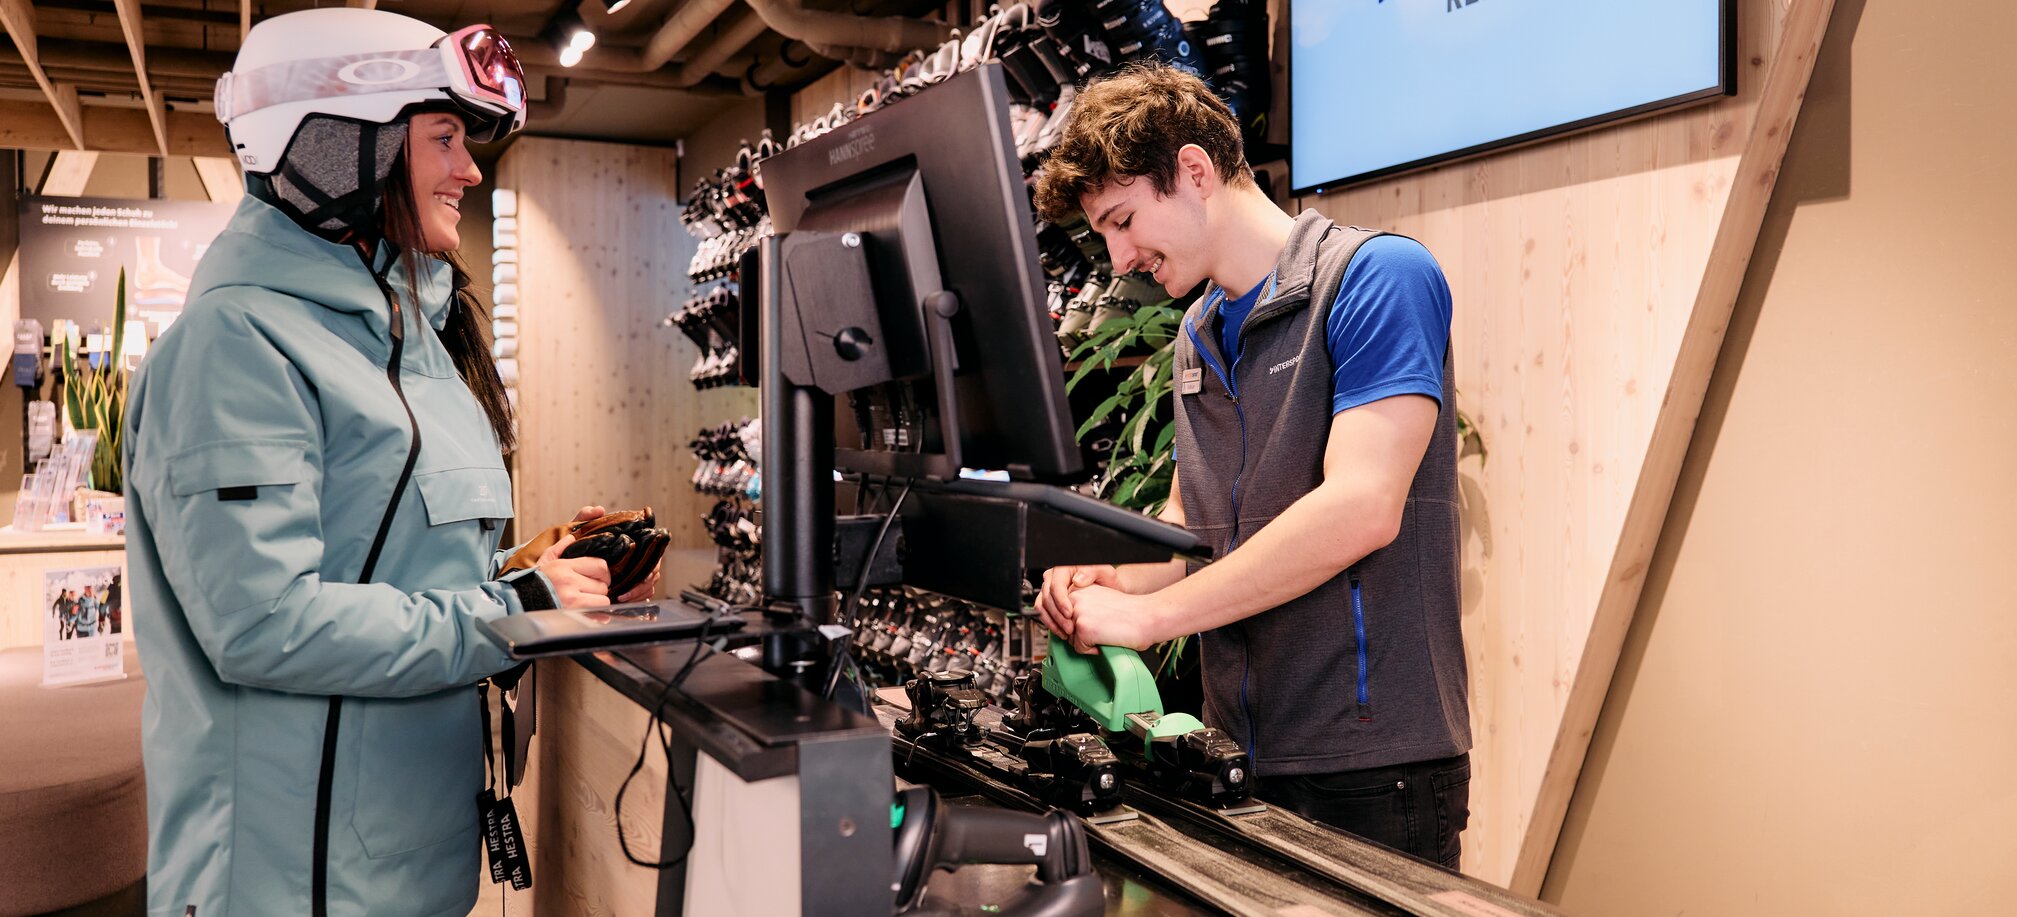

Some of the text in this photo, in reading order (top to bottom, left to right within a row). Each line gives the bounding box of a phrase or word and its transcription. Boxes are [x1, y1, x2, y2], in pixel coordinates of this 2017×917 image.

[42, 204, 58, 214] Wir
[59, 205, 92, 215] machen
[92, 206, 116, 218] jeden
[117, 207, 142, 217] Schuh
[42, 215, 74, 225] deinem
[486, 808, 500, 852] HESTRA
[500, 813, 518, 859] HESTRA
